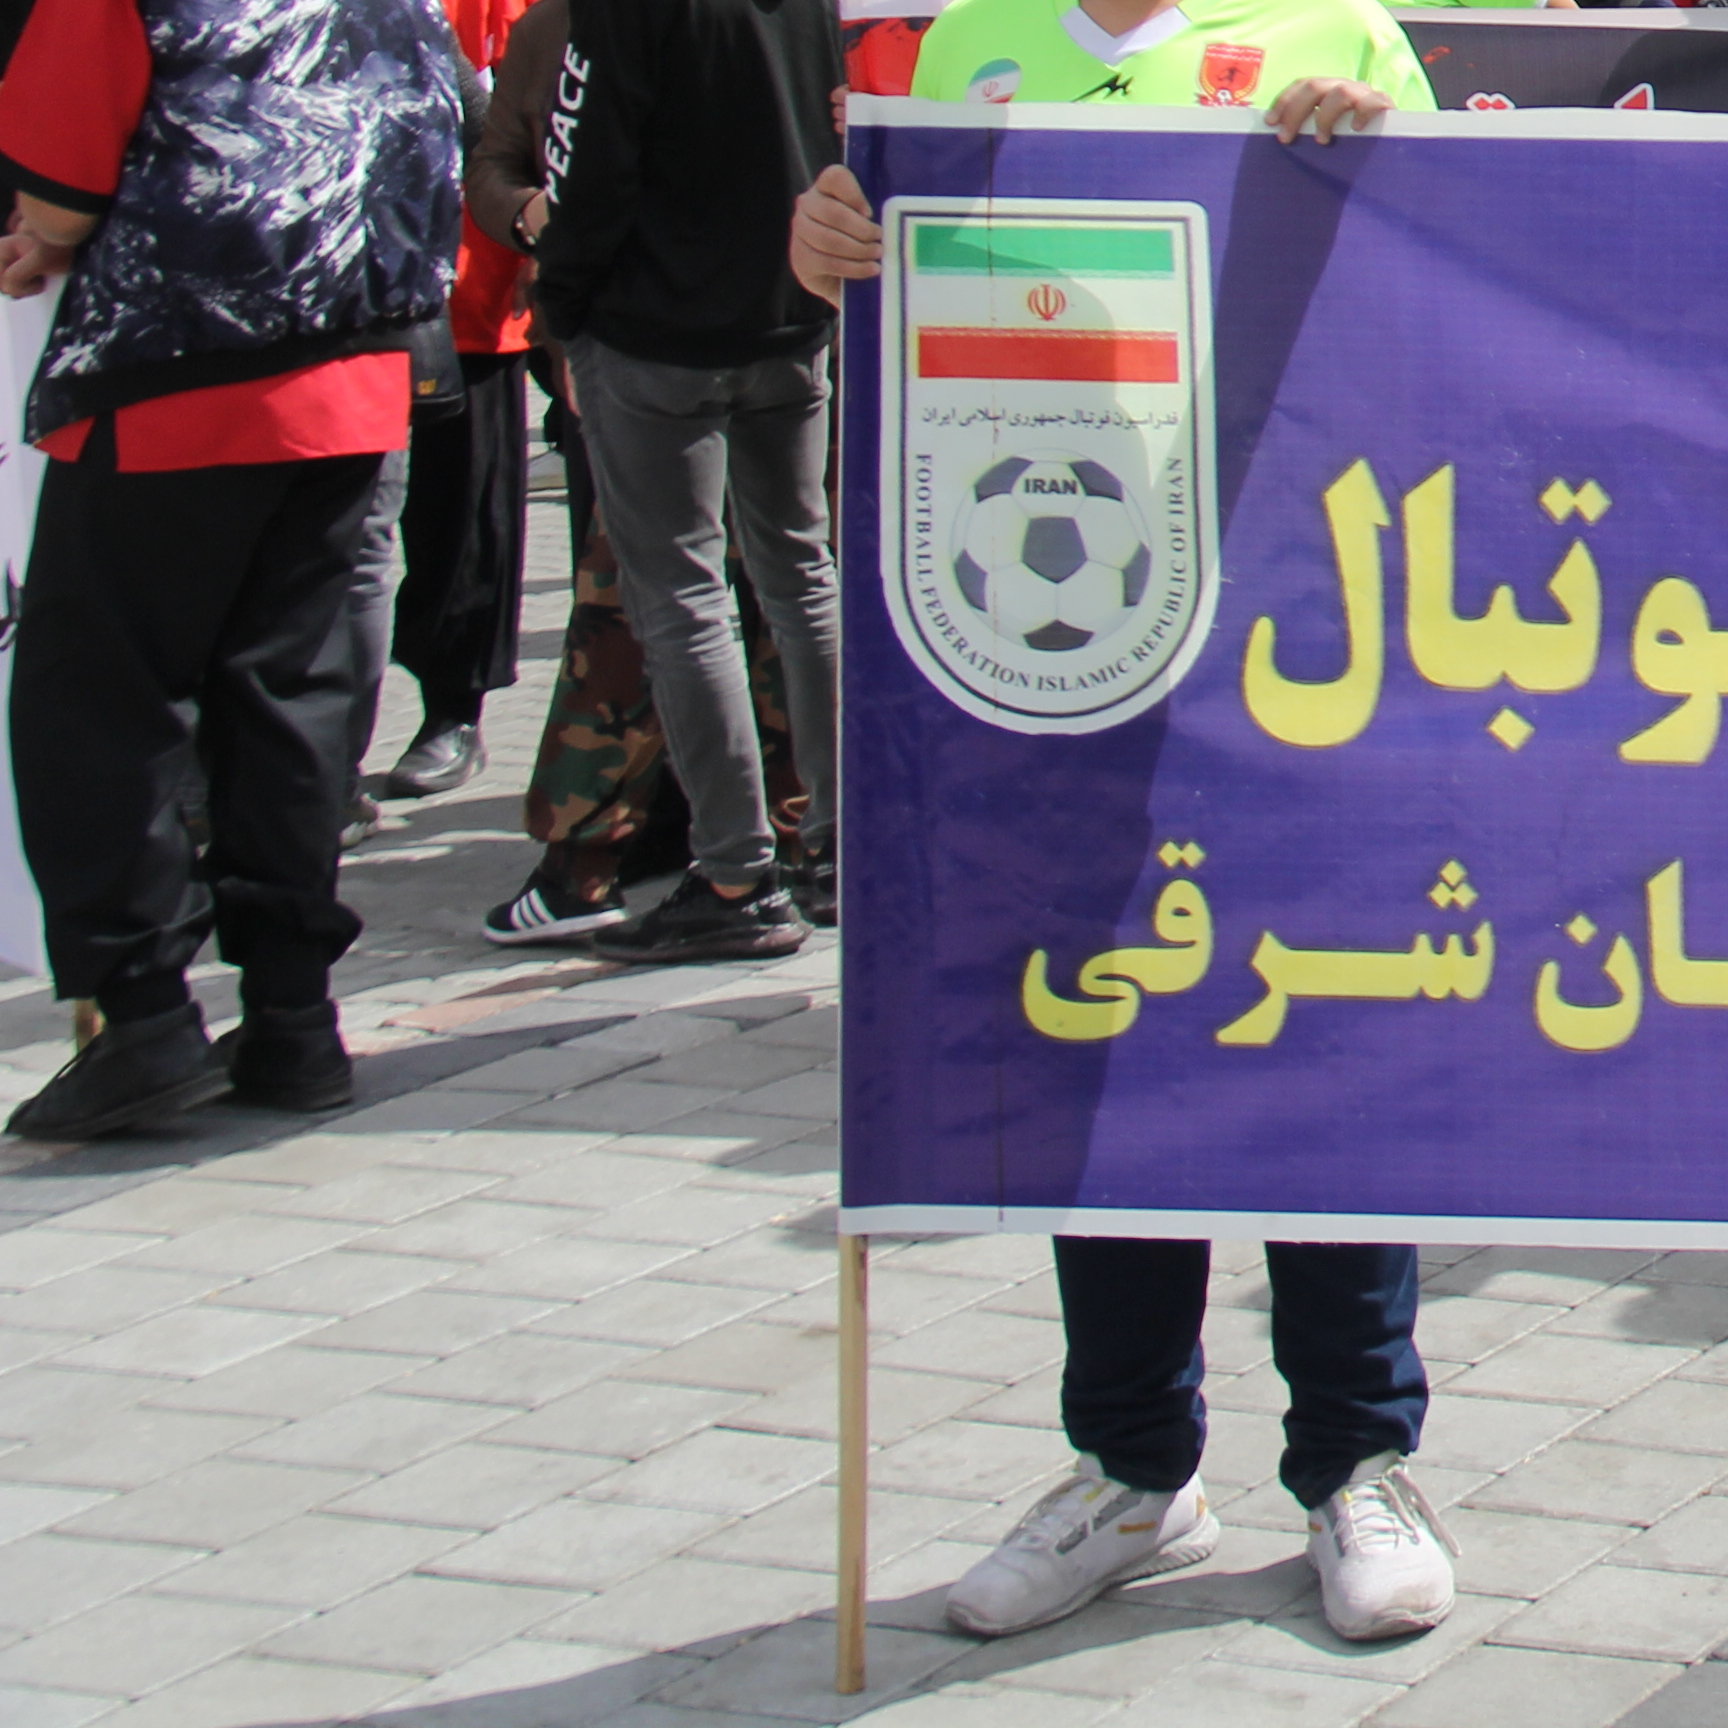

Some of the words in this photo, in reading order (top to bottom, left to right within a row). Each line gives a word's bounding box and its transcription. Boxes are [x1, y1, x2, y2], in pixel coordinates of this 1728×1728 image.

[921, 406, 956, 428] ایران
[957, 407, 1007, 428] اسلامی
[1008, 410, 1066, 429] جمهوری
[1069, 409, 1110, 430] فوتبال
[1113, 411, 1180, 431] فدراسیون
[1023, 476, 1079, 495] IRAN
[1167, 456, 1185, 516] IRAN
[914, 452, 933, 583] FOOTBALL
[1168, 522, 1187, 554] OF
[1130, 556, 1189, 663] REPUBLIC
[920, 585, 1031, 690] FEDERATION
[1035, 656, 1134, 692] ISLAMIC
[1019, 837, 1495, 1046] شرقی
